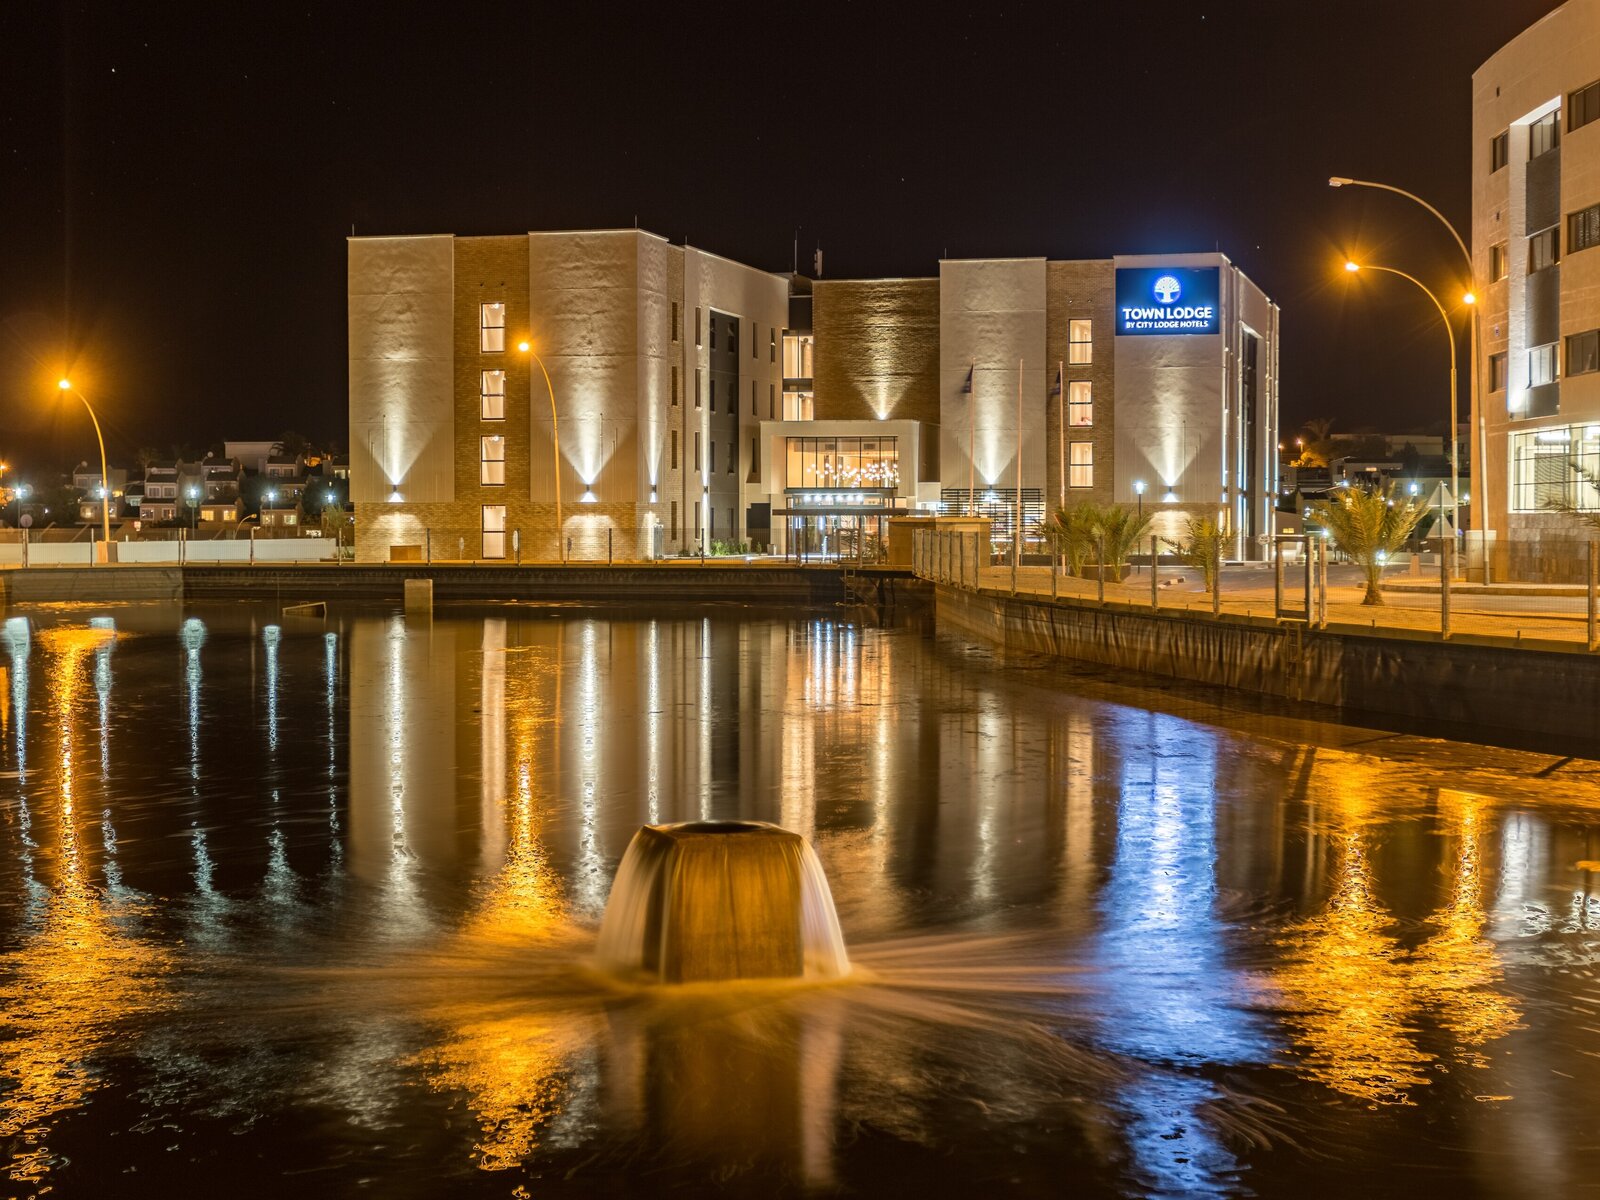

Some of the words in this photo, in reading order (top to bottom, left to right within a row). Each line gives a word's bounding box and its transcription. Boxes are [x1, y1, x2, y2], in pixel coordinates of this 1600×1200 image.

[1123, 308, 1164, 320] TOWN
[1166, 307, 1212, 319] LODGE
[1180, 320, 1208, 328] HOTELS
